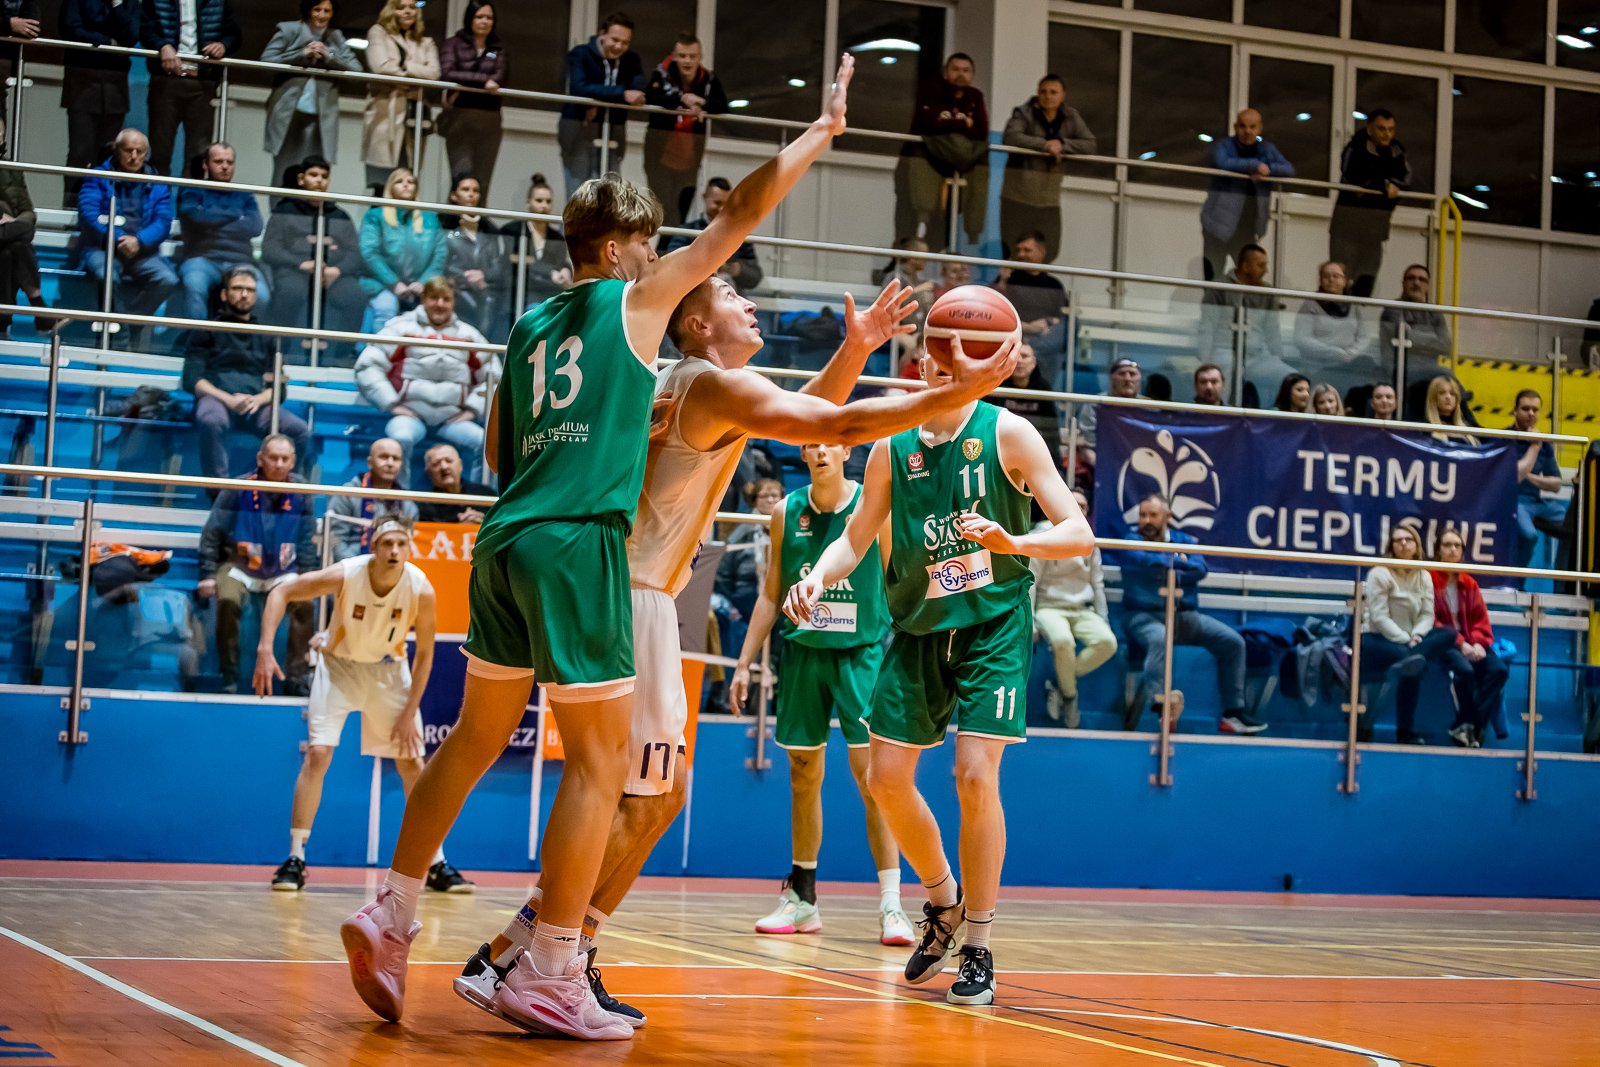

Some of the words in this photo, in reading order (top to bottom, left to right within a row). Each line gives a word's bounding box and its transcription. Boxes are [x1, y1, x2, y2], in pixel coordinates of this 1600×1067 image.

[527, 335, 584, 418] 13
[959, 463, 986, 498] 11
[1297, 450, 1457, 502] TERMY
[945, 567, 990, 587] Systems
[813, 615, 855, 625] Systems
[993, 685, 1017, 721] 11
[640, 742, 670, 781] 17
